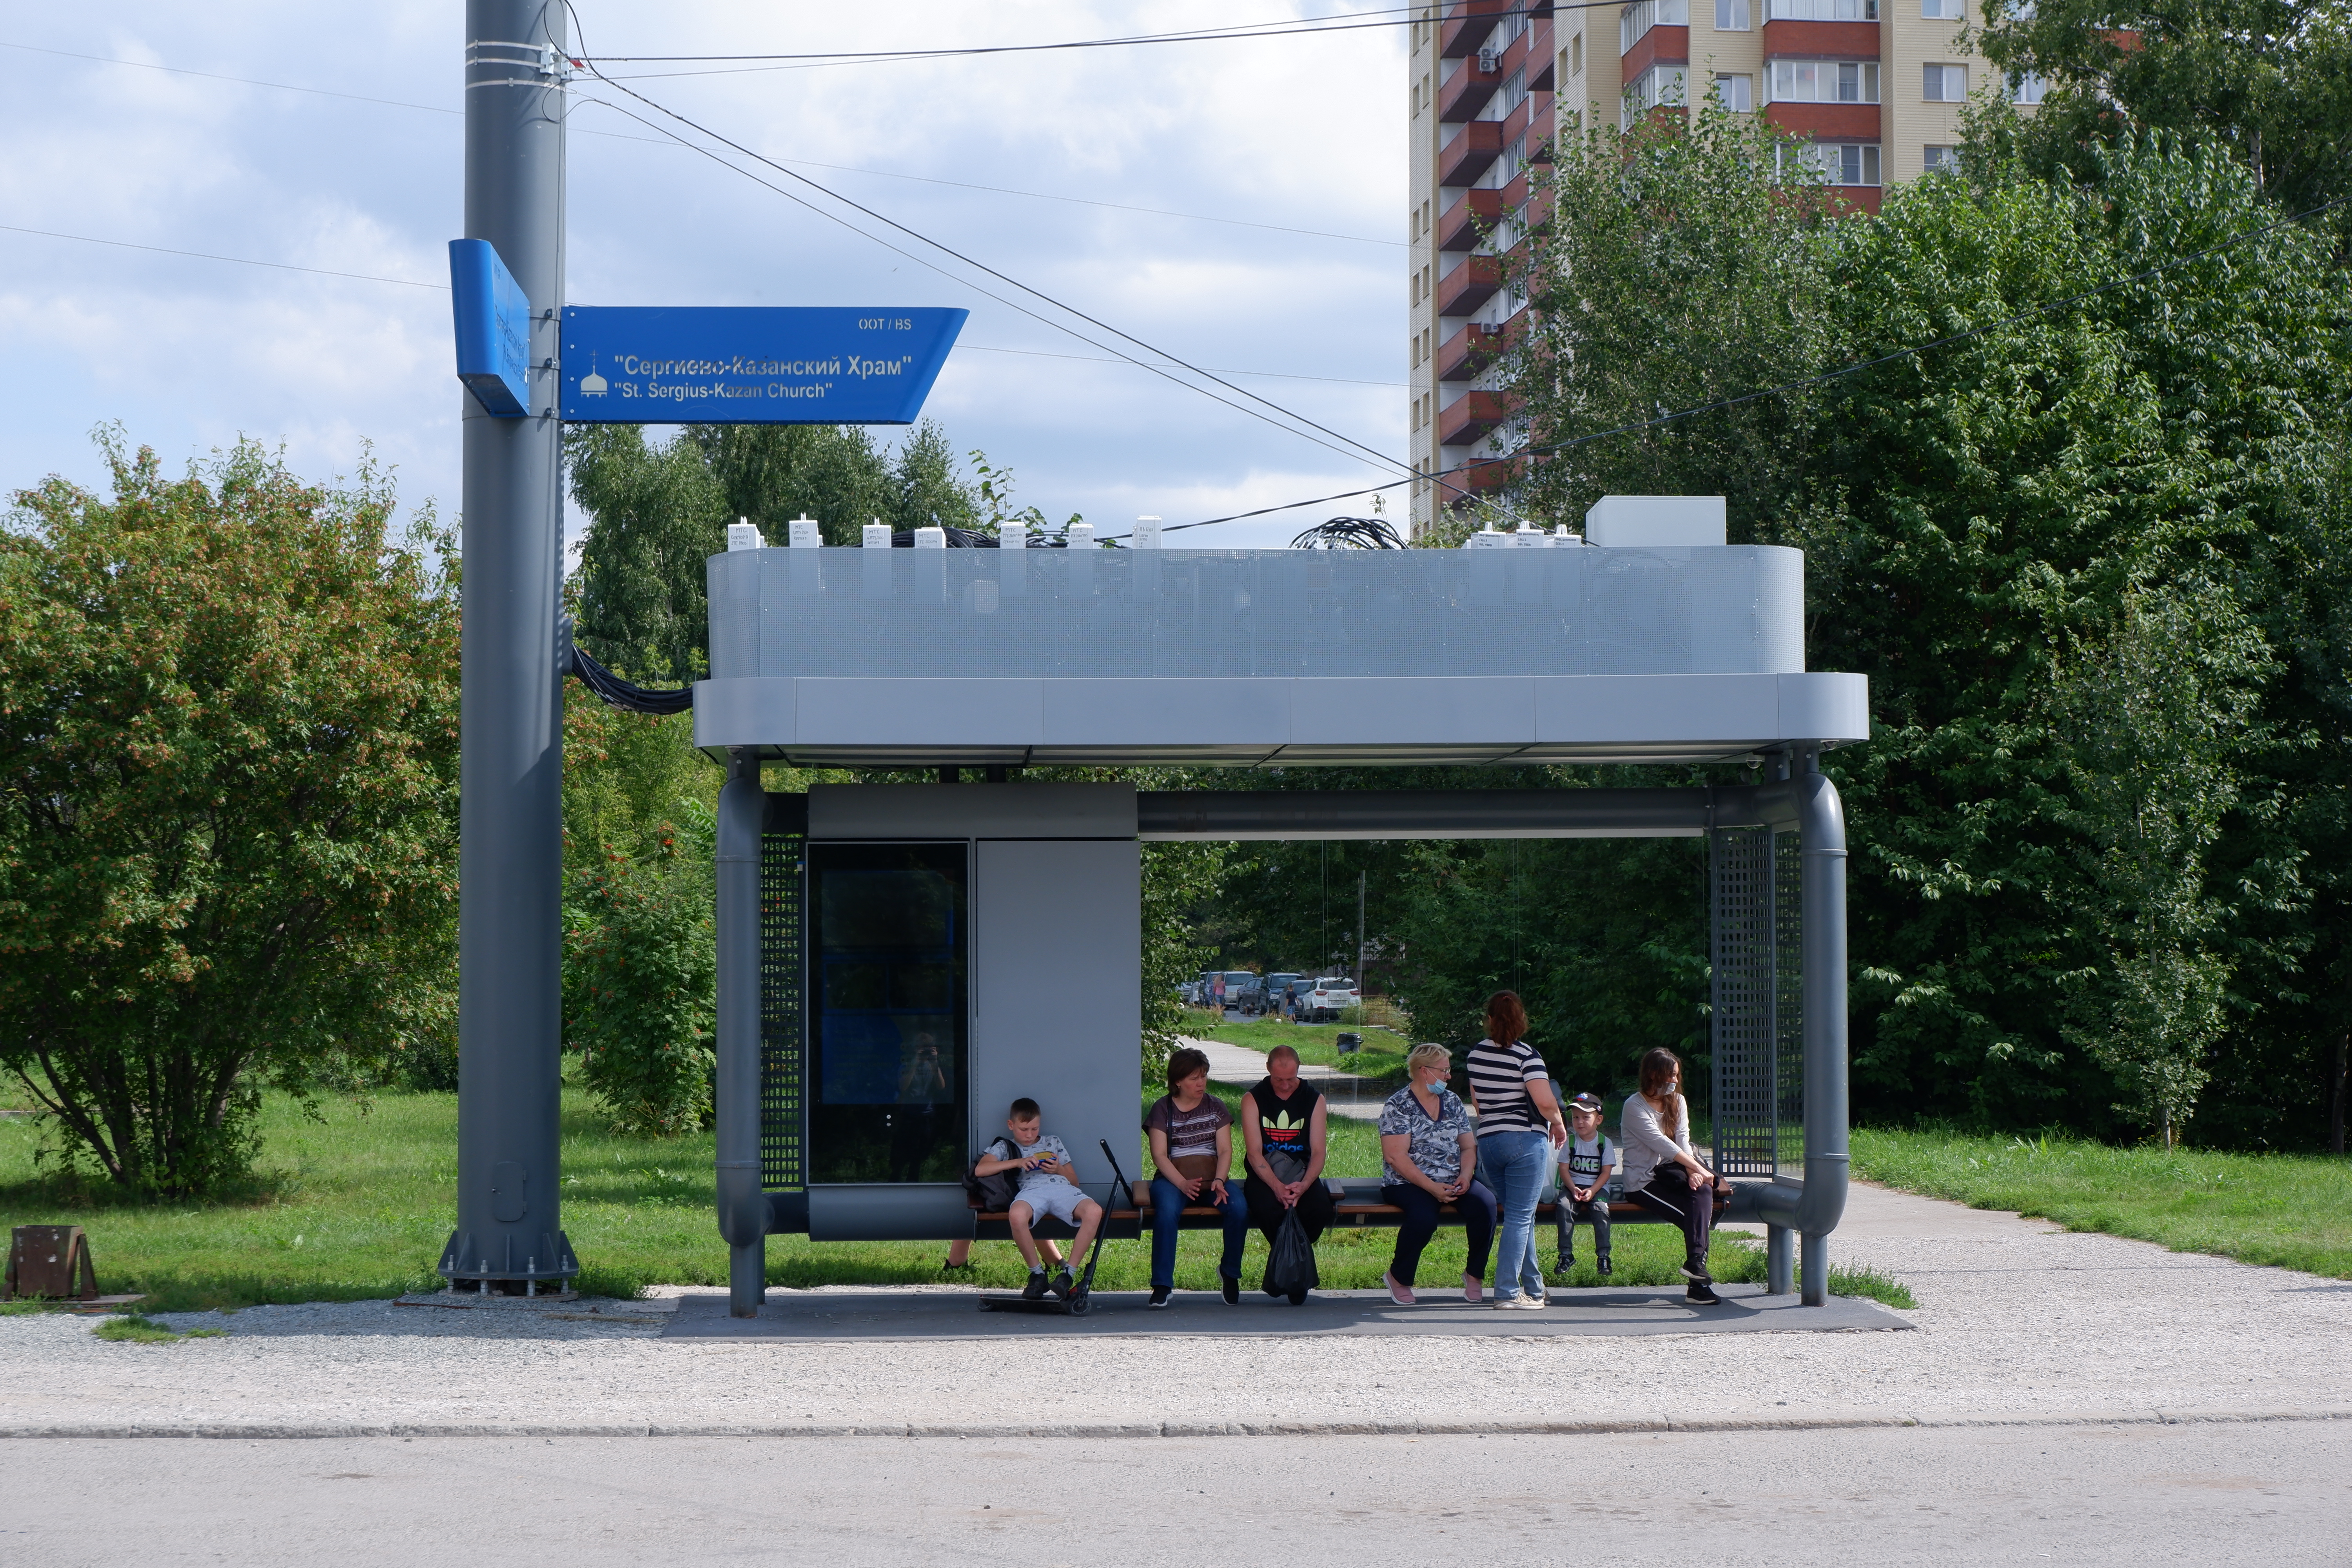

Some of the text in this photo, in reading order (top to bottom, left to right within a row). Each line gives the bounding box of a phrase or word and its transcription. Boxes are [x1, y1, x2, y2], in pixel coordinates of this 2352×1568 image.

[895, 319, 912, 330] BS
[615, 355, 912, 380] "Сергиево-Казанский Храм"
[615, 382, 833, 402] "St. Sergius-Kazan Church"
[1570, 1156, 1601, 1172] JOKE
